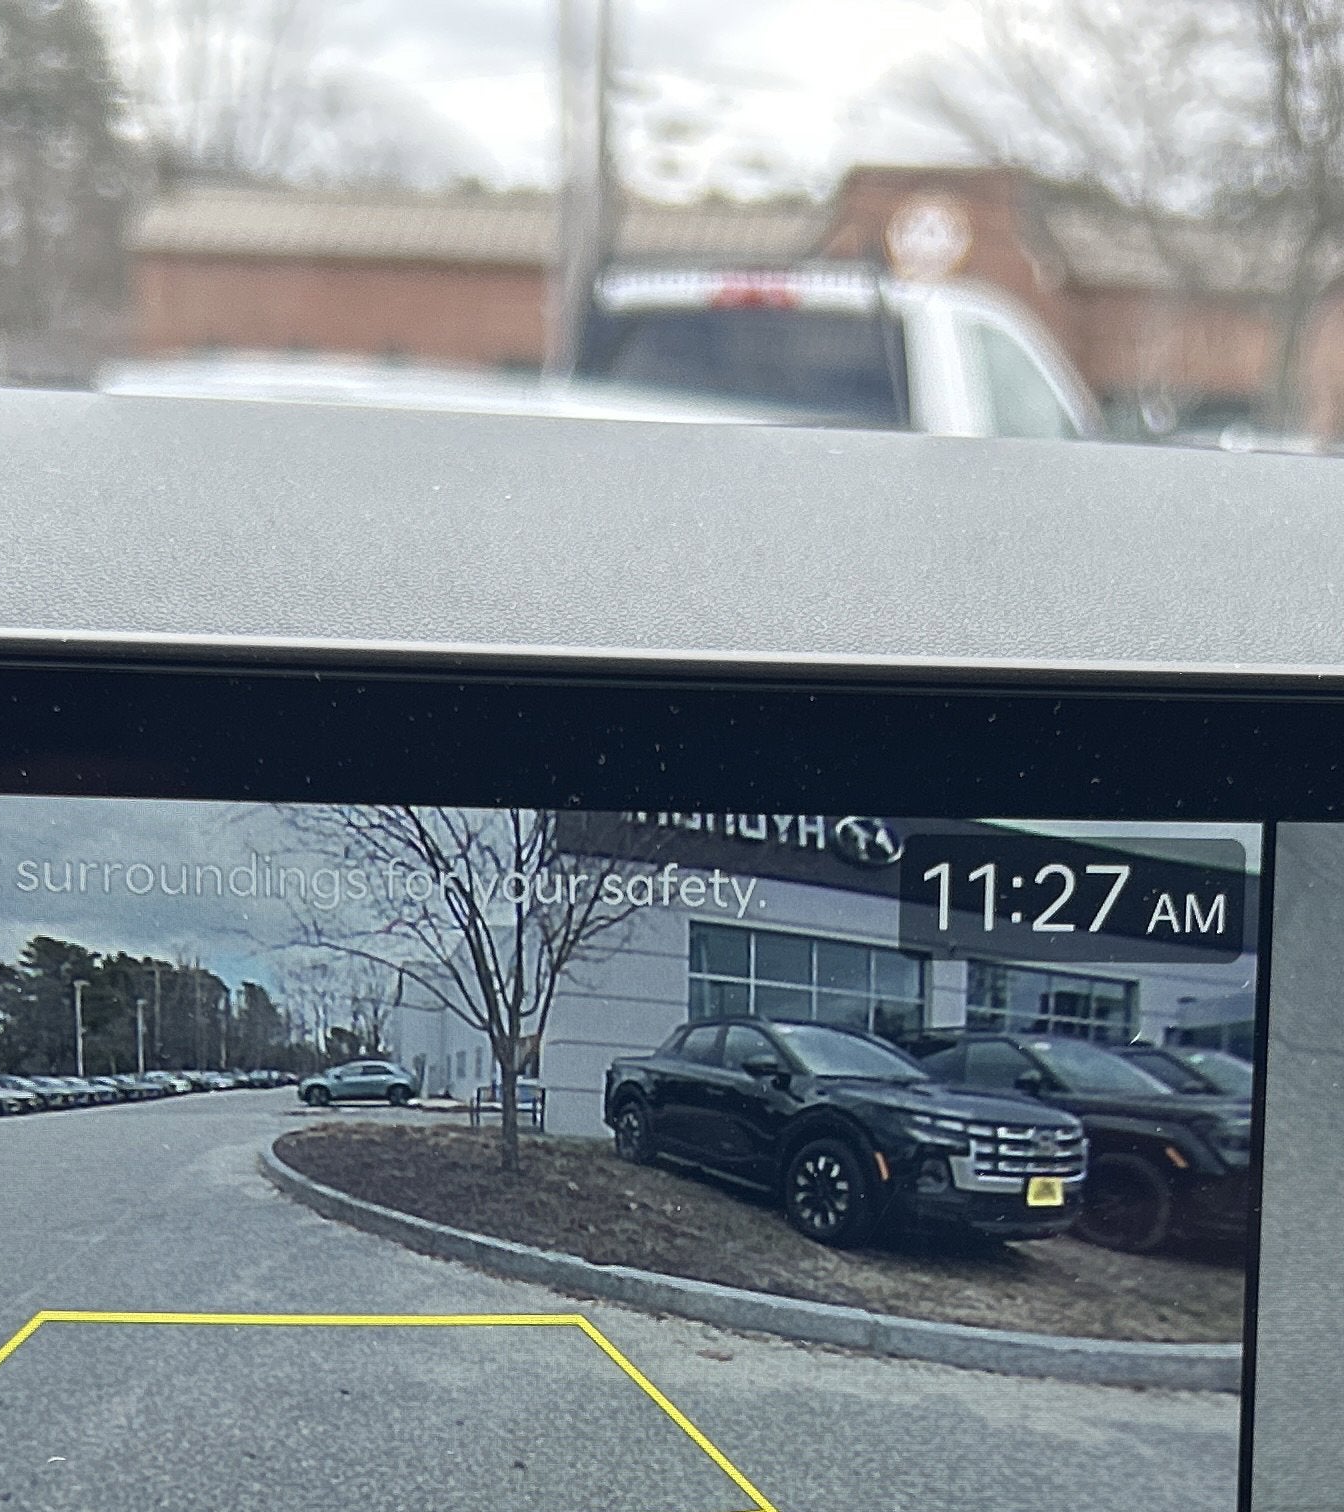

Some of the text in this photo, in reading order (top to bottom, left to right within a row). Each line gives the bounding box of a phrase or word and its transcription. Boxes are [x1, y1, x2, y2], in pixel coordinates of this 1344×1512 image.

[16, 851, 369, 910] surroundings
[382, 857, 456, 902] for
[470, 870, 589, 915] your
[601, 862, 767, 919] safety.
[923, 862, 1227, 934] 11:27 AM
